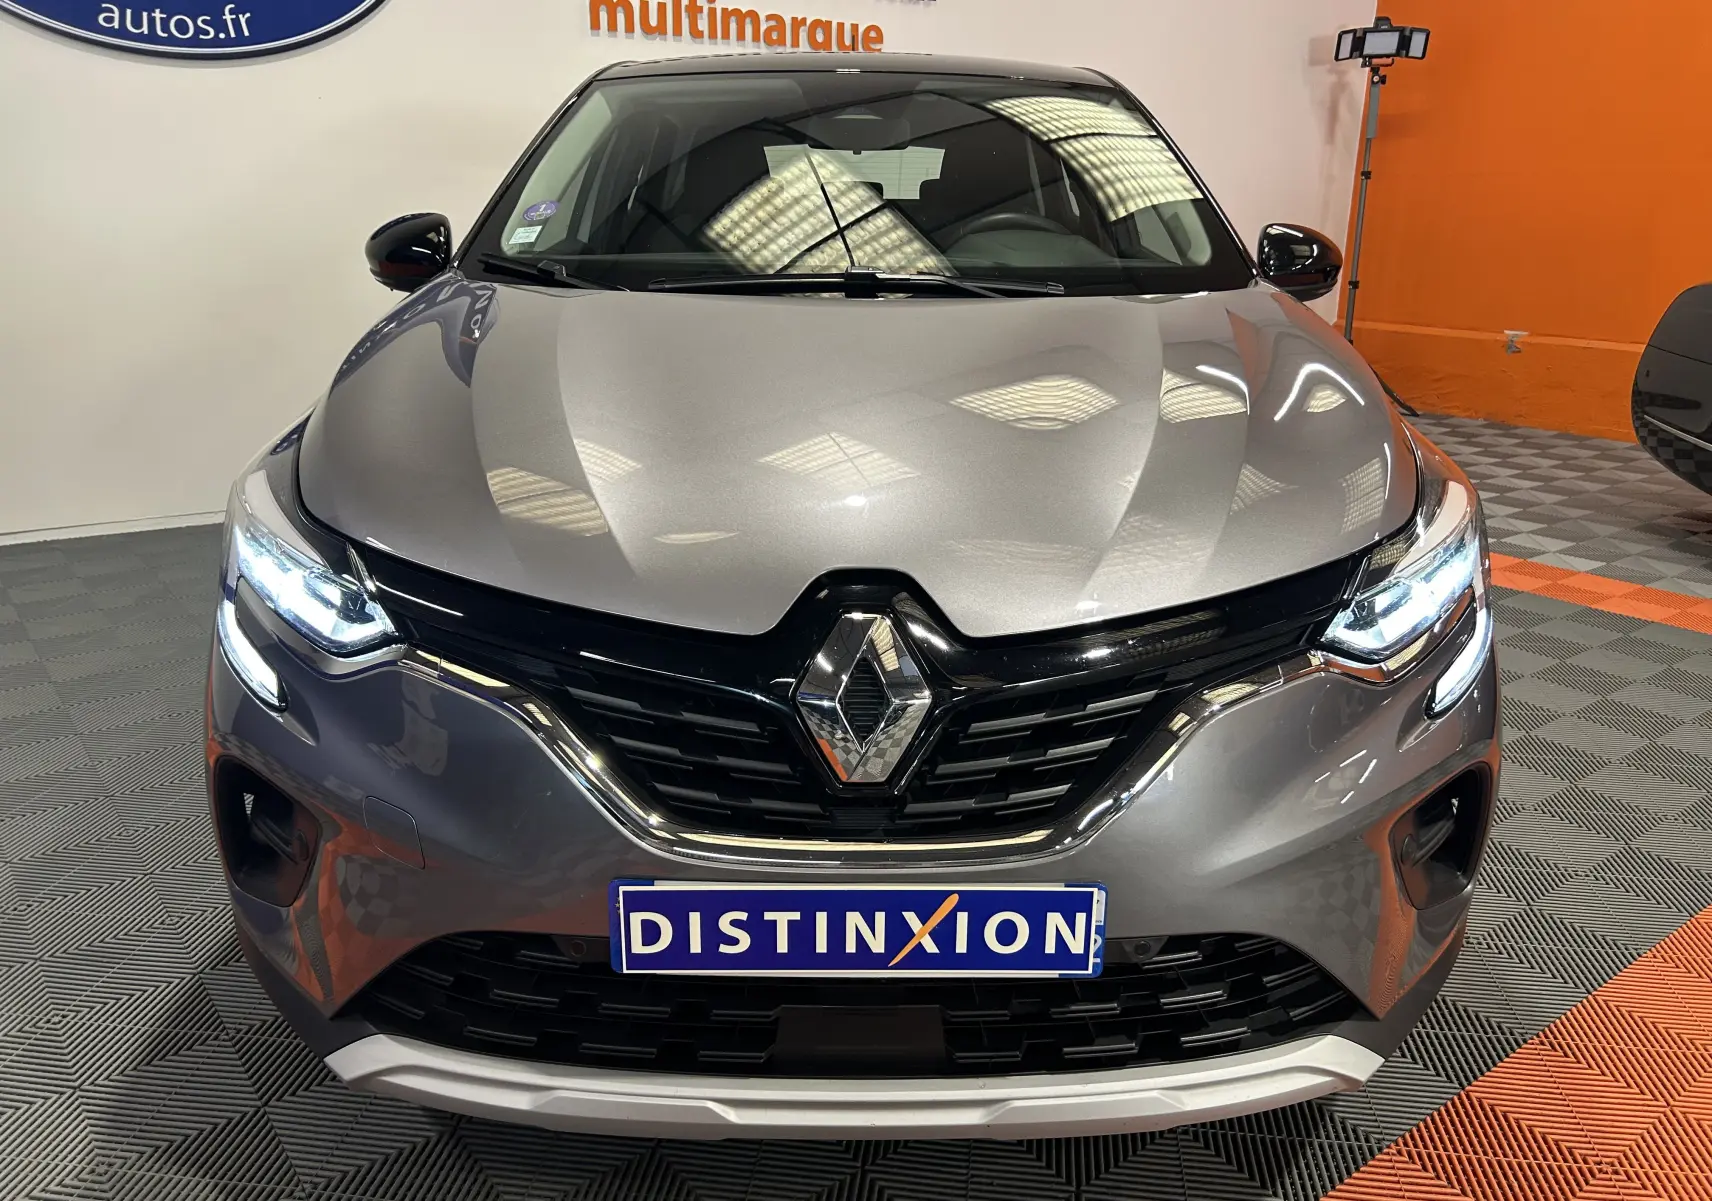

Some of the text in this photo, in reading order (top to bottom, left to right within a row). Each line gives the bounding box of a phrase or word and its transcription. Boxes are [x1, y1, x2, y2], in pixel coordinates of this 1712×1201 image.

[98, 3, 251, 39] autos.fr
[589, 0, 884, 52] multimarque
[629, 893, 1086, 967] DISTINXION
